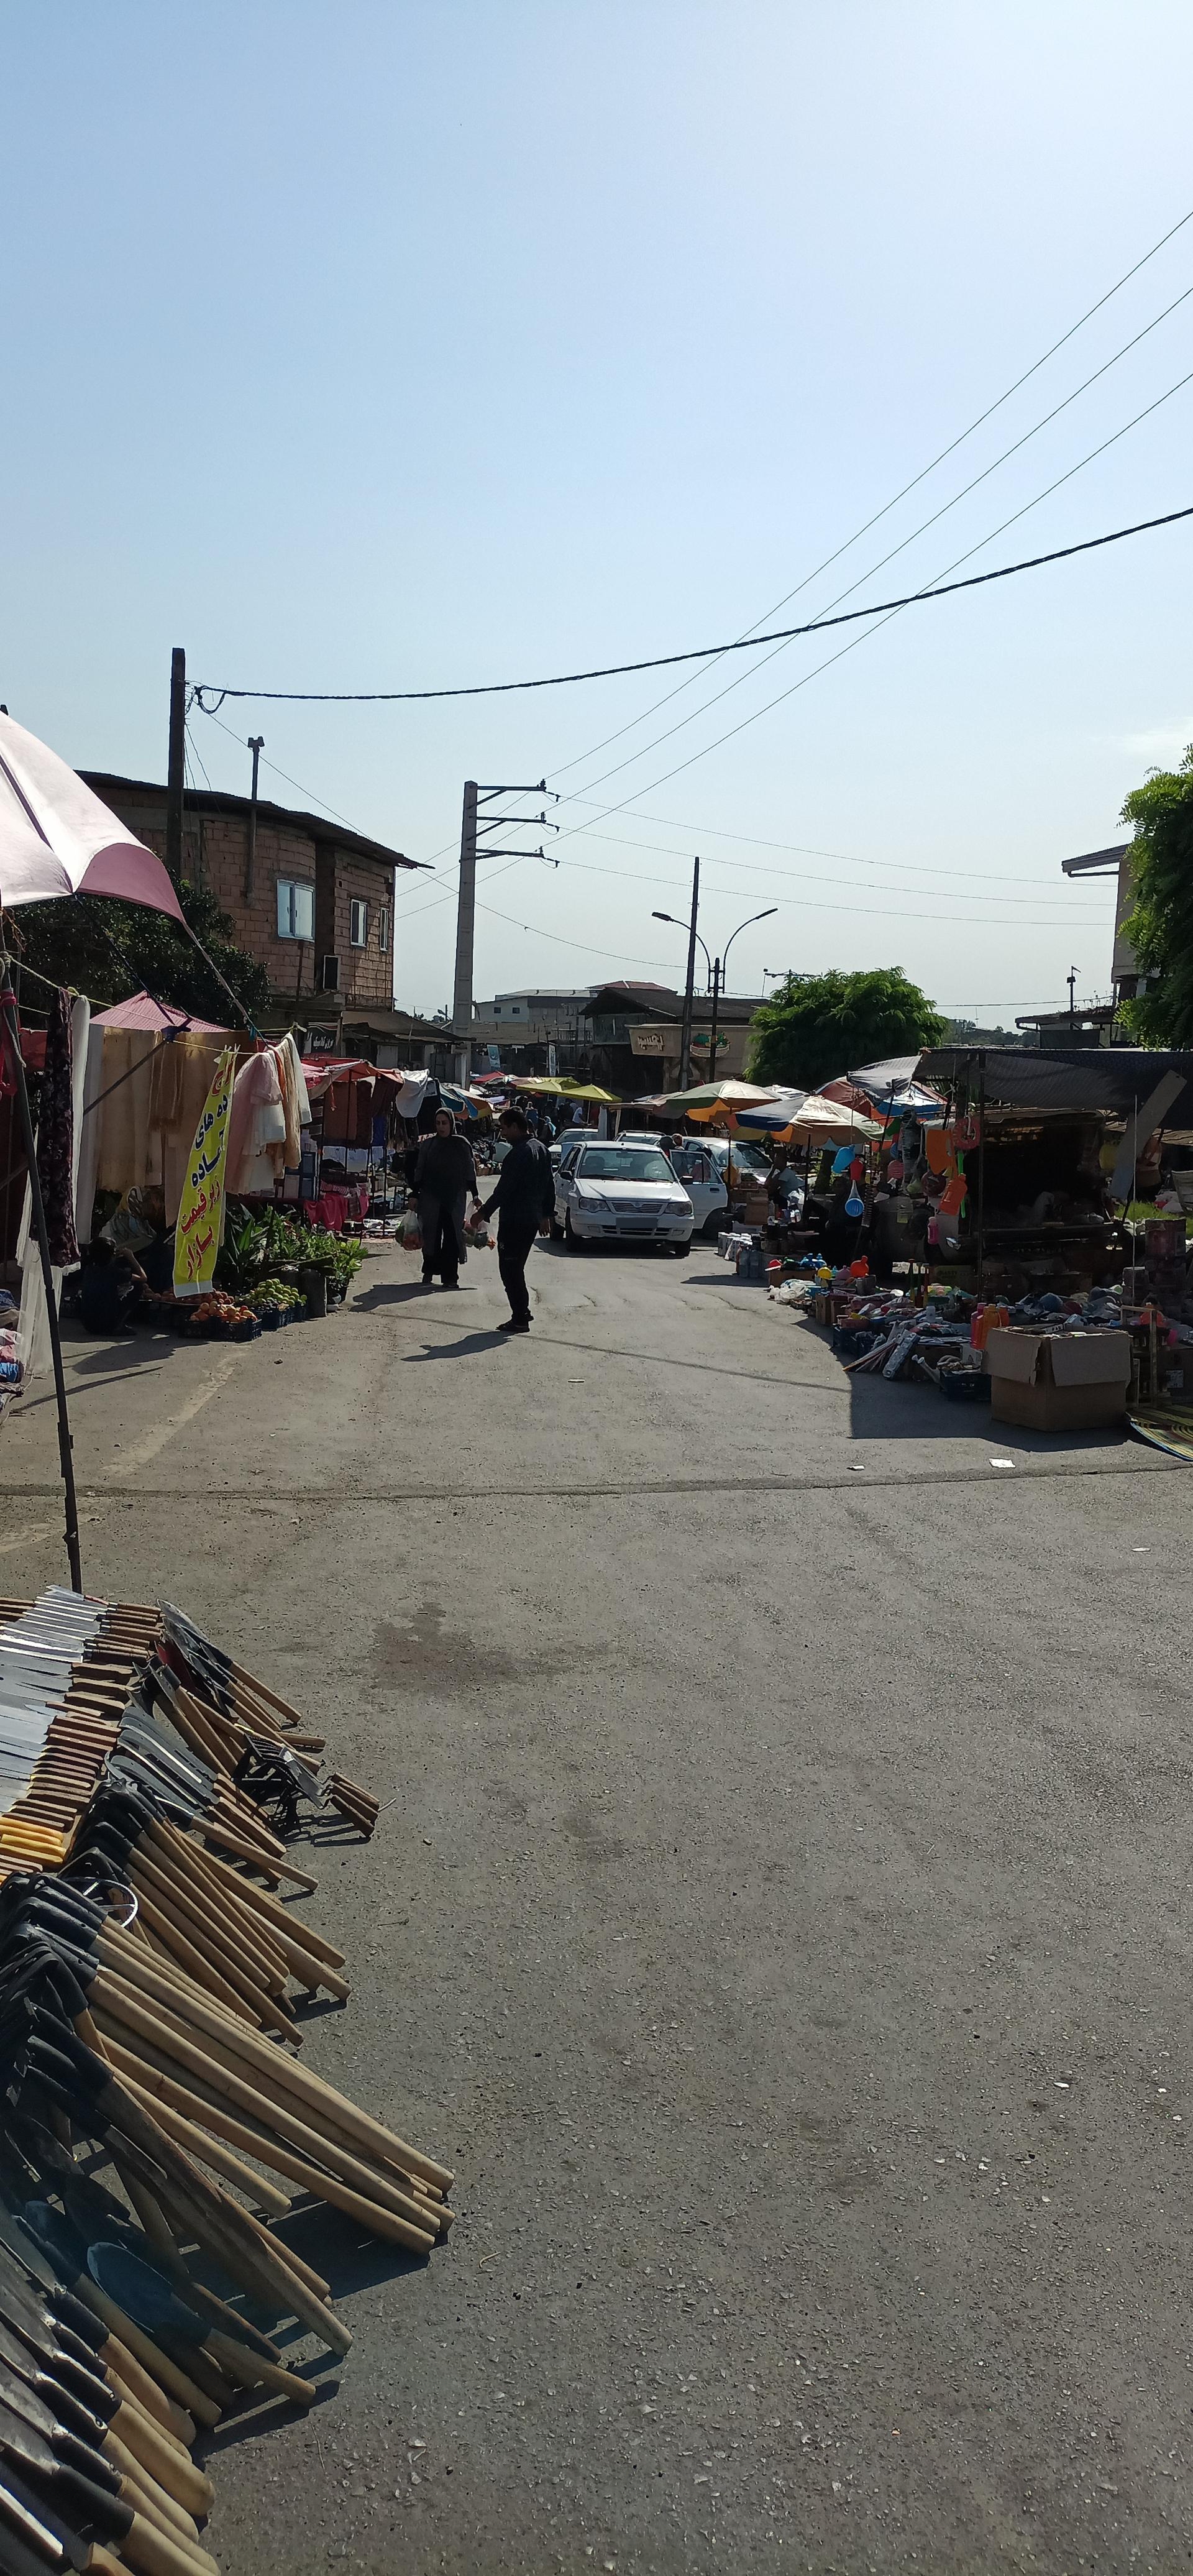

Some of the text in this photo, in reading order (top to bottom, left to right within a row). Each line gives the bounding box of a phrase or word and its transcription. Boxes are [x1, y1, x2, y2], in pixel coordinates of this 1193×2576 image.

[195, 1113, 214, 1150] های
[180, 1175, 221, 1234] زیر قیمت
[187, 1225, 214, 1280] بازار
